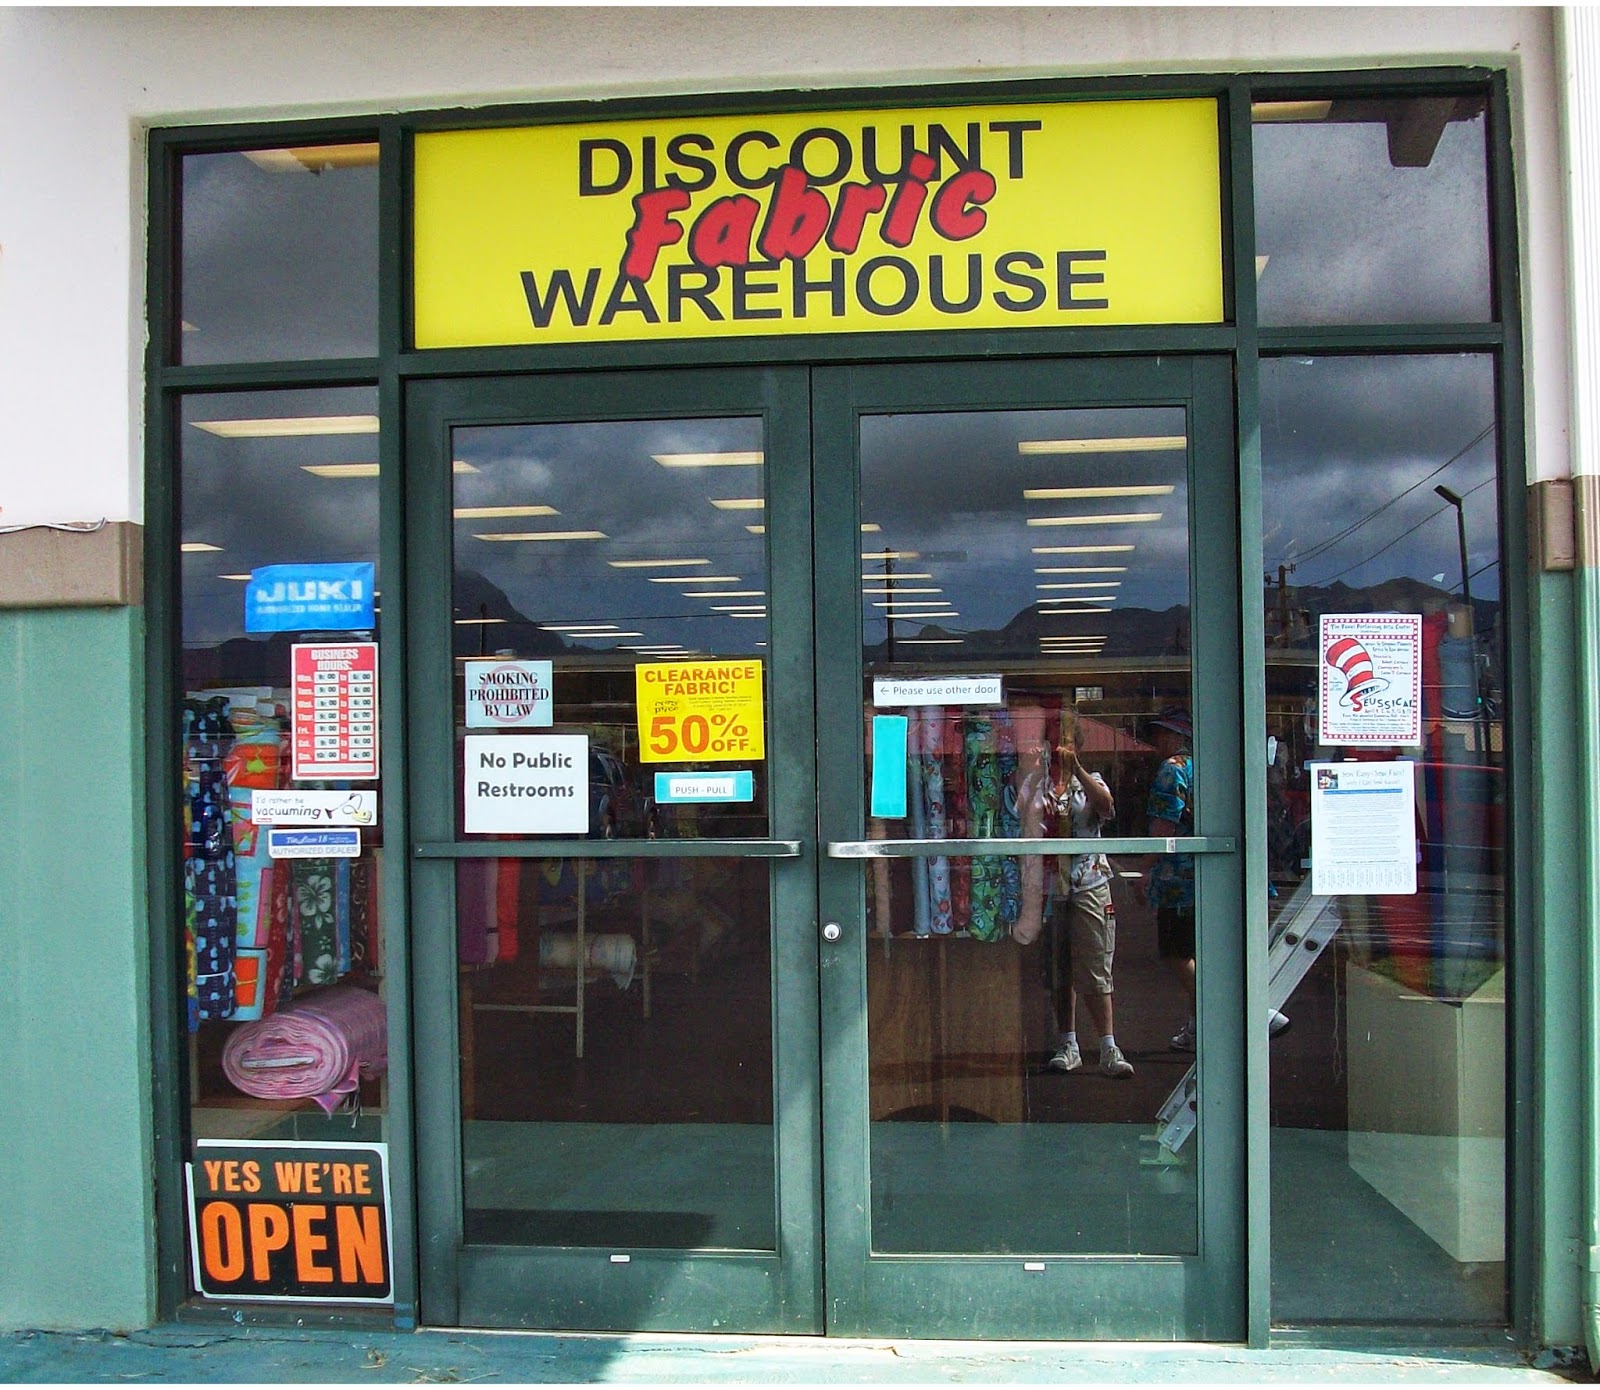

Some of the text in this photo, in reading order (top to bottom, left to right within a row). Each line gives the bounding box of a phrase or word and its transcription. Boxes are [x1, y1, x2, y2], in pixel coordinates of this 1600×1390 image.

[579, 121, 1041, 197] DISCOUNT
[620, 149, 996, 282] Fabric
[521, 250, 1108, 328] WAREHOUSE
[256, 580, 363, 602] JUKI
[479, 672, 538, 685] SMOKING
[644, 667, 755, 683] CLEARANCE
[469, 688, 549, 701] PROHIBITED
[664, 681, 736, 696] FABRIC!
[893, 685, 997, 695] Please use other door
[484, 703, 533, 717] BY LAW
[1350, 692, 1414, 712] SEUSSICAL
[650, 714, 748, 755] 50%
[711, 739, 749, 752] OFF
[480, 752, 572, 768] No Public
[477, 781, 574, 797] Restrooms
[675, 786, 699, 794] PUSH
[706, 786, 727, 794] PULL
[255, 805, 322, 820] vacuuming
[272, 846, 358, 855] AUTHORIZED DEALER
[203, 1160, 372, 1194] YES WE'RE
[202, 1201, 385, 1284] OPEN
